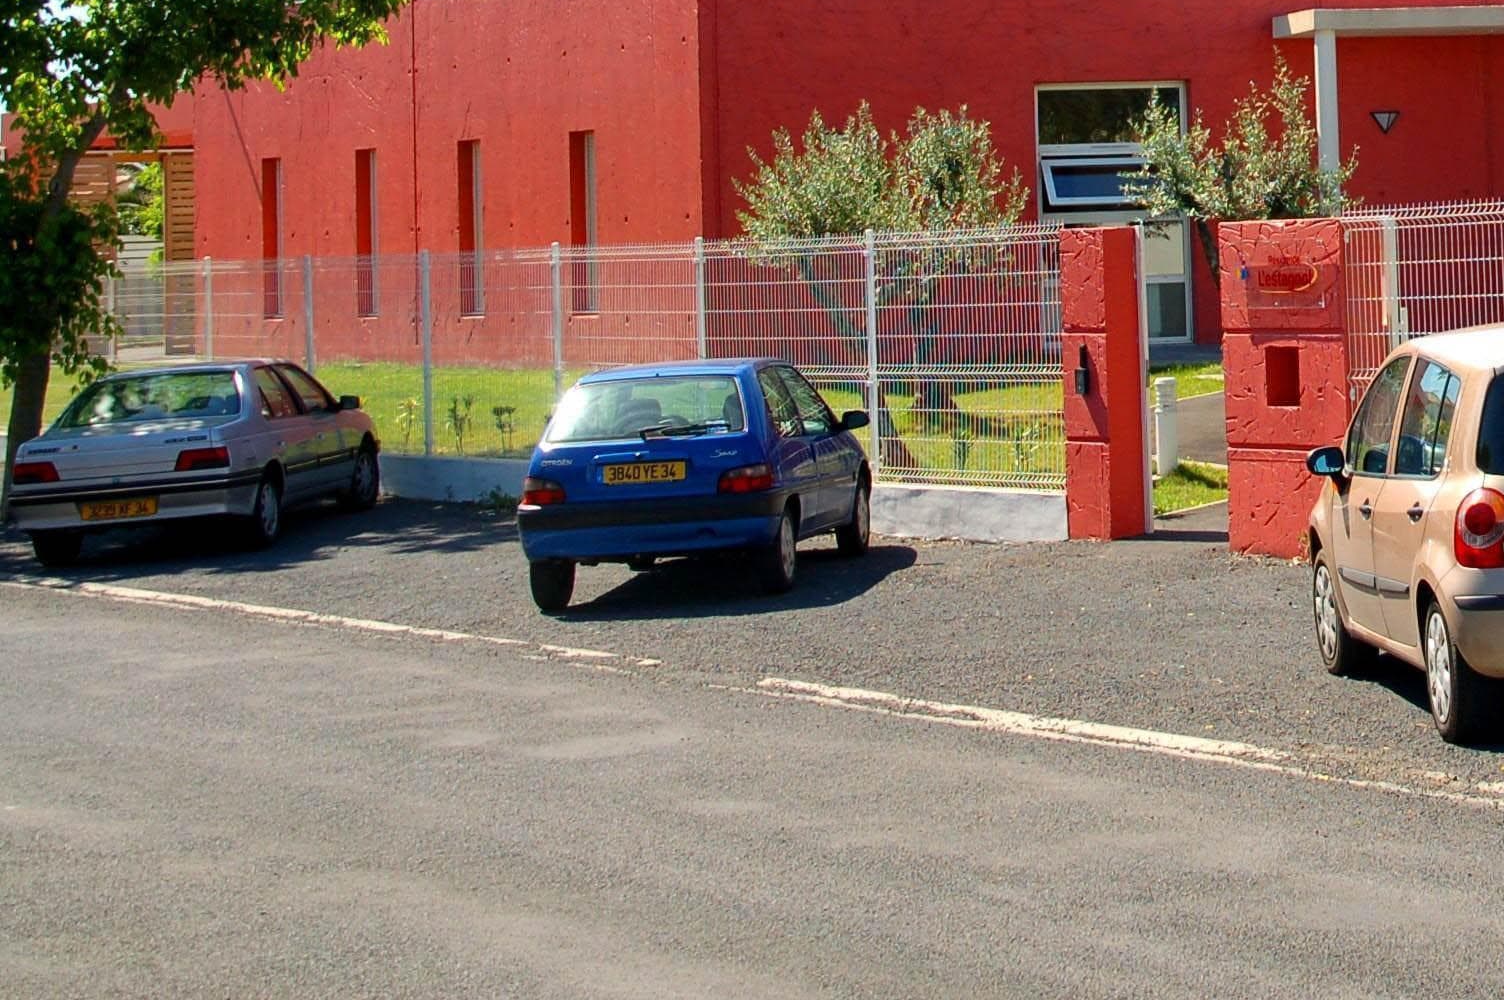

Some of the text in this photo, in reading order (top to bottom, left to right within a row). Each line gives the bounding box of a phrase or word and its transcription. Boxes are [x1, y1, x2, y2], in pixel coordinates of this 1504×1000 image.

[608, 465, 677, 482] 3840 YE 34
